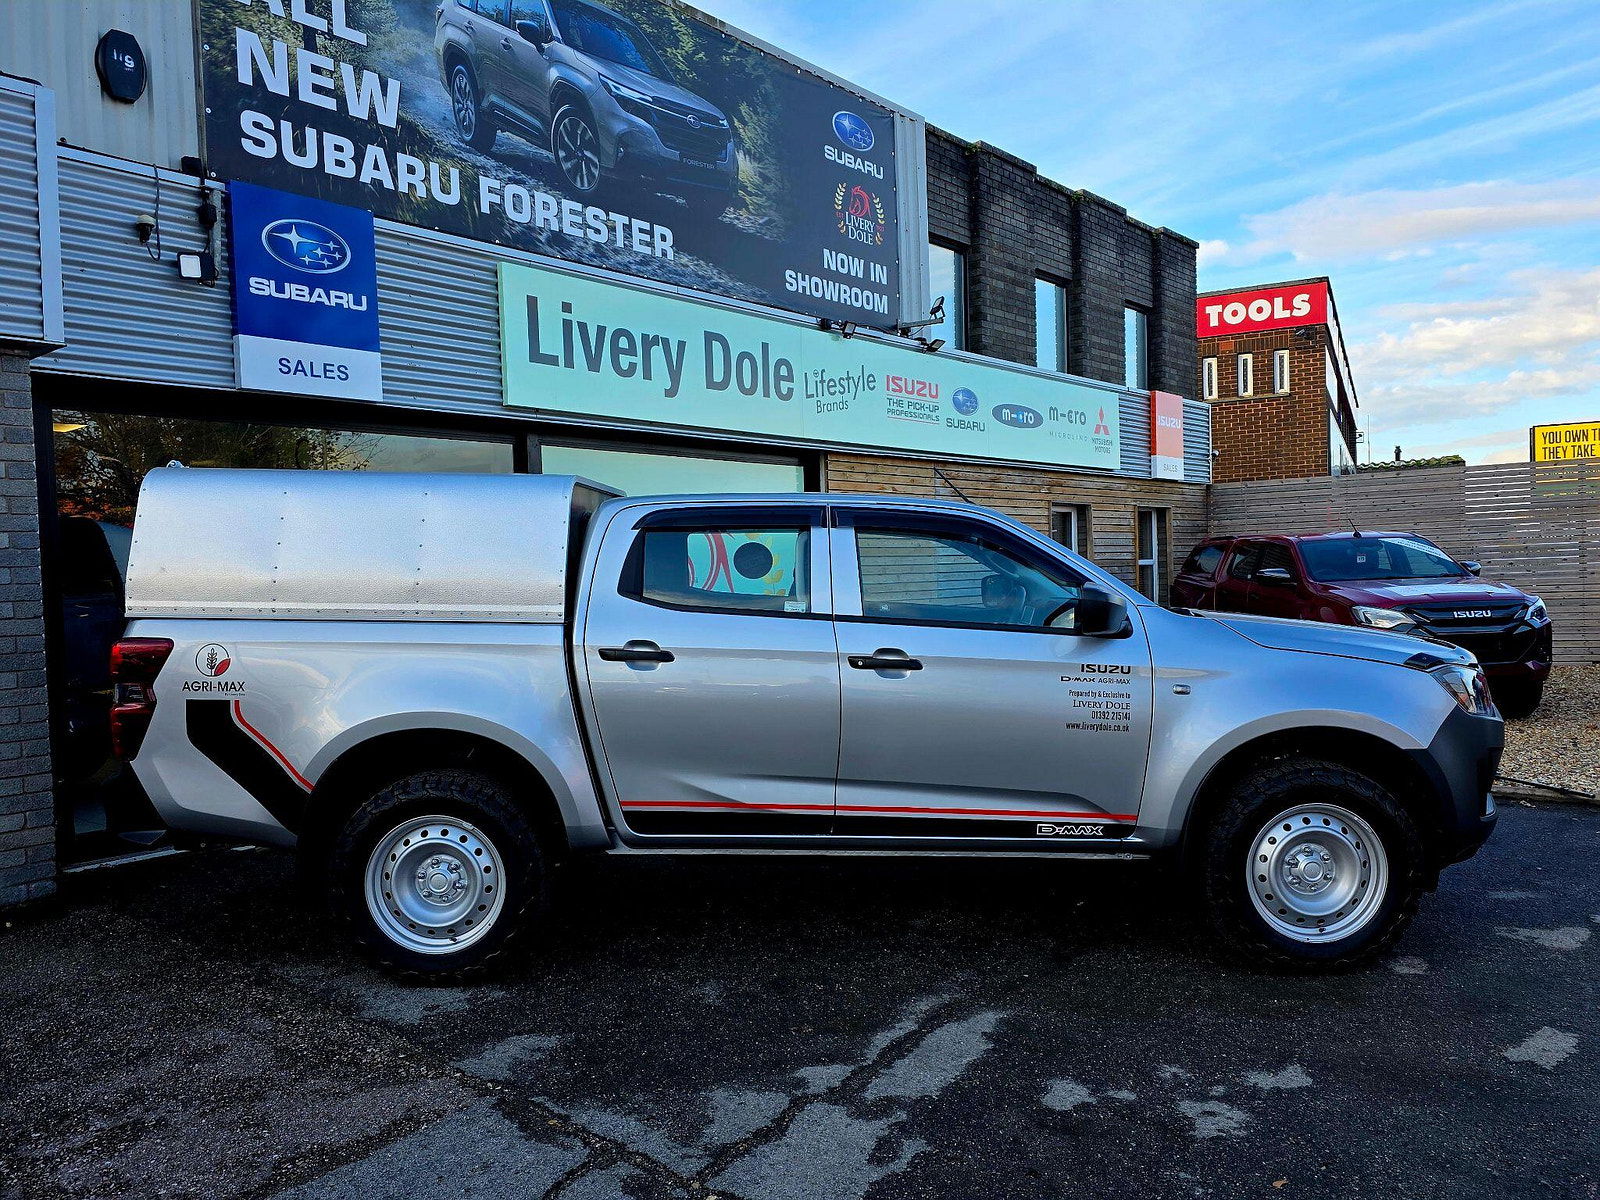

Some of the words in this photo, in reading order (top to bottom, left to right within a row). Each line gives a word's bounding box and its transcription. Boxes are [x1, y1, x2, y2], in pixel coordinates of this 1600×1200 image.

[236, 0, 368, 47] LL
[235, 27, 401, 129] NEW
[824, 144, 884, 180] SUBARU
[240, 109, 462, 206] SUBARU
[478, 175, 675, 261] FORESTER
[845, 211, 875, 233] LIVERY
[848, 225, 874, 246] DOLE
[823, 248, 865, 279] NOW
[870, 262, 888, 285] IN
[249, 276, 368, 312] SUBARU
[785, 269, 889, 315] SHOWROOM
[1205, 293, 1311, 327] TOOLS
[526, 294, 687, 398] Livery
[703, 329, 795, 402] Dole
[278, 357, 350, 382] SALES
[804, 364, 877, 400] Lifestyle
[886, 374, 939, 400] ISUZU
[816, 396, 849, 414] Brands
[887, 397, 904, 409] THE
[907, 400, 940, 414] PICK-UP
[886, 408, 940, 422] PROFESSIONALS
[1158, 414, 1182, 429] ISUZU
[946, 417, 986, 432] SUBARU
[1542, 431, 1562, 444] YOU
[1565, 429, 1589, 443] OWN
[1592, 428, 1600, 441] T
[1542, 446, 1568, 460] THEY
[1571, 444, 1596, 458] TAKE
[1163, 463, 1179, 473] SALES
[1453, 609, 1492, 619] ISUZU
[1080, 663, 1131, 675] ISUZU
[182, 680, 246, 692] AGRI-MAX
[1060, 675, 1096, 683] D-MAX
[1098, 677, 1131, 685] AGRI-MAX
[1069, 689, 1090, 698] Prepared
[1091, 690, 1097, 699] by
[1097, 690, 1102, 698] &
[1102, 690, 1125, 699] Exclusive
[1125, 691, 1131, 699] to
[1073, 699, 1103, 709] LIVERY
[1105, 700, 1131, 710] DOLE
[1091, 710, 1110, 720] 01392
[1036, 823, 1104, 836] D-MAX
